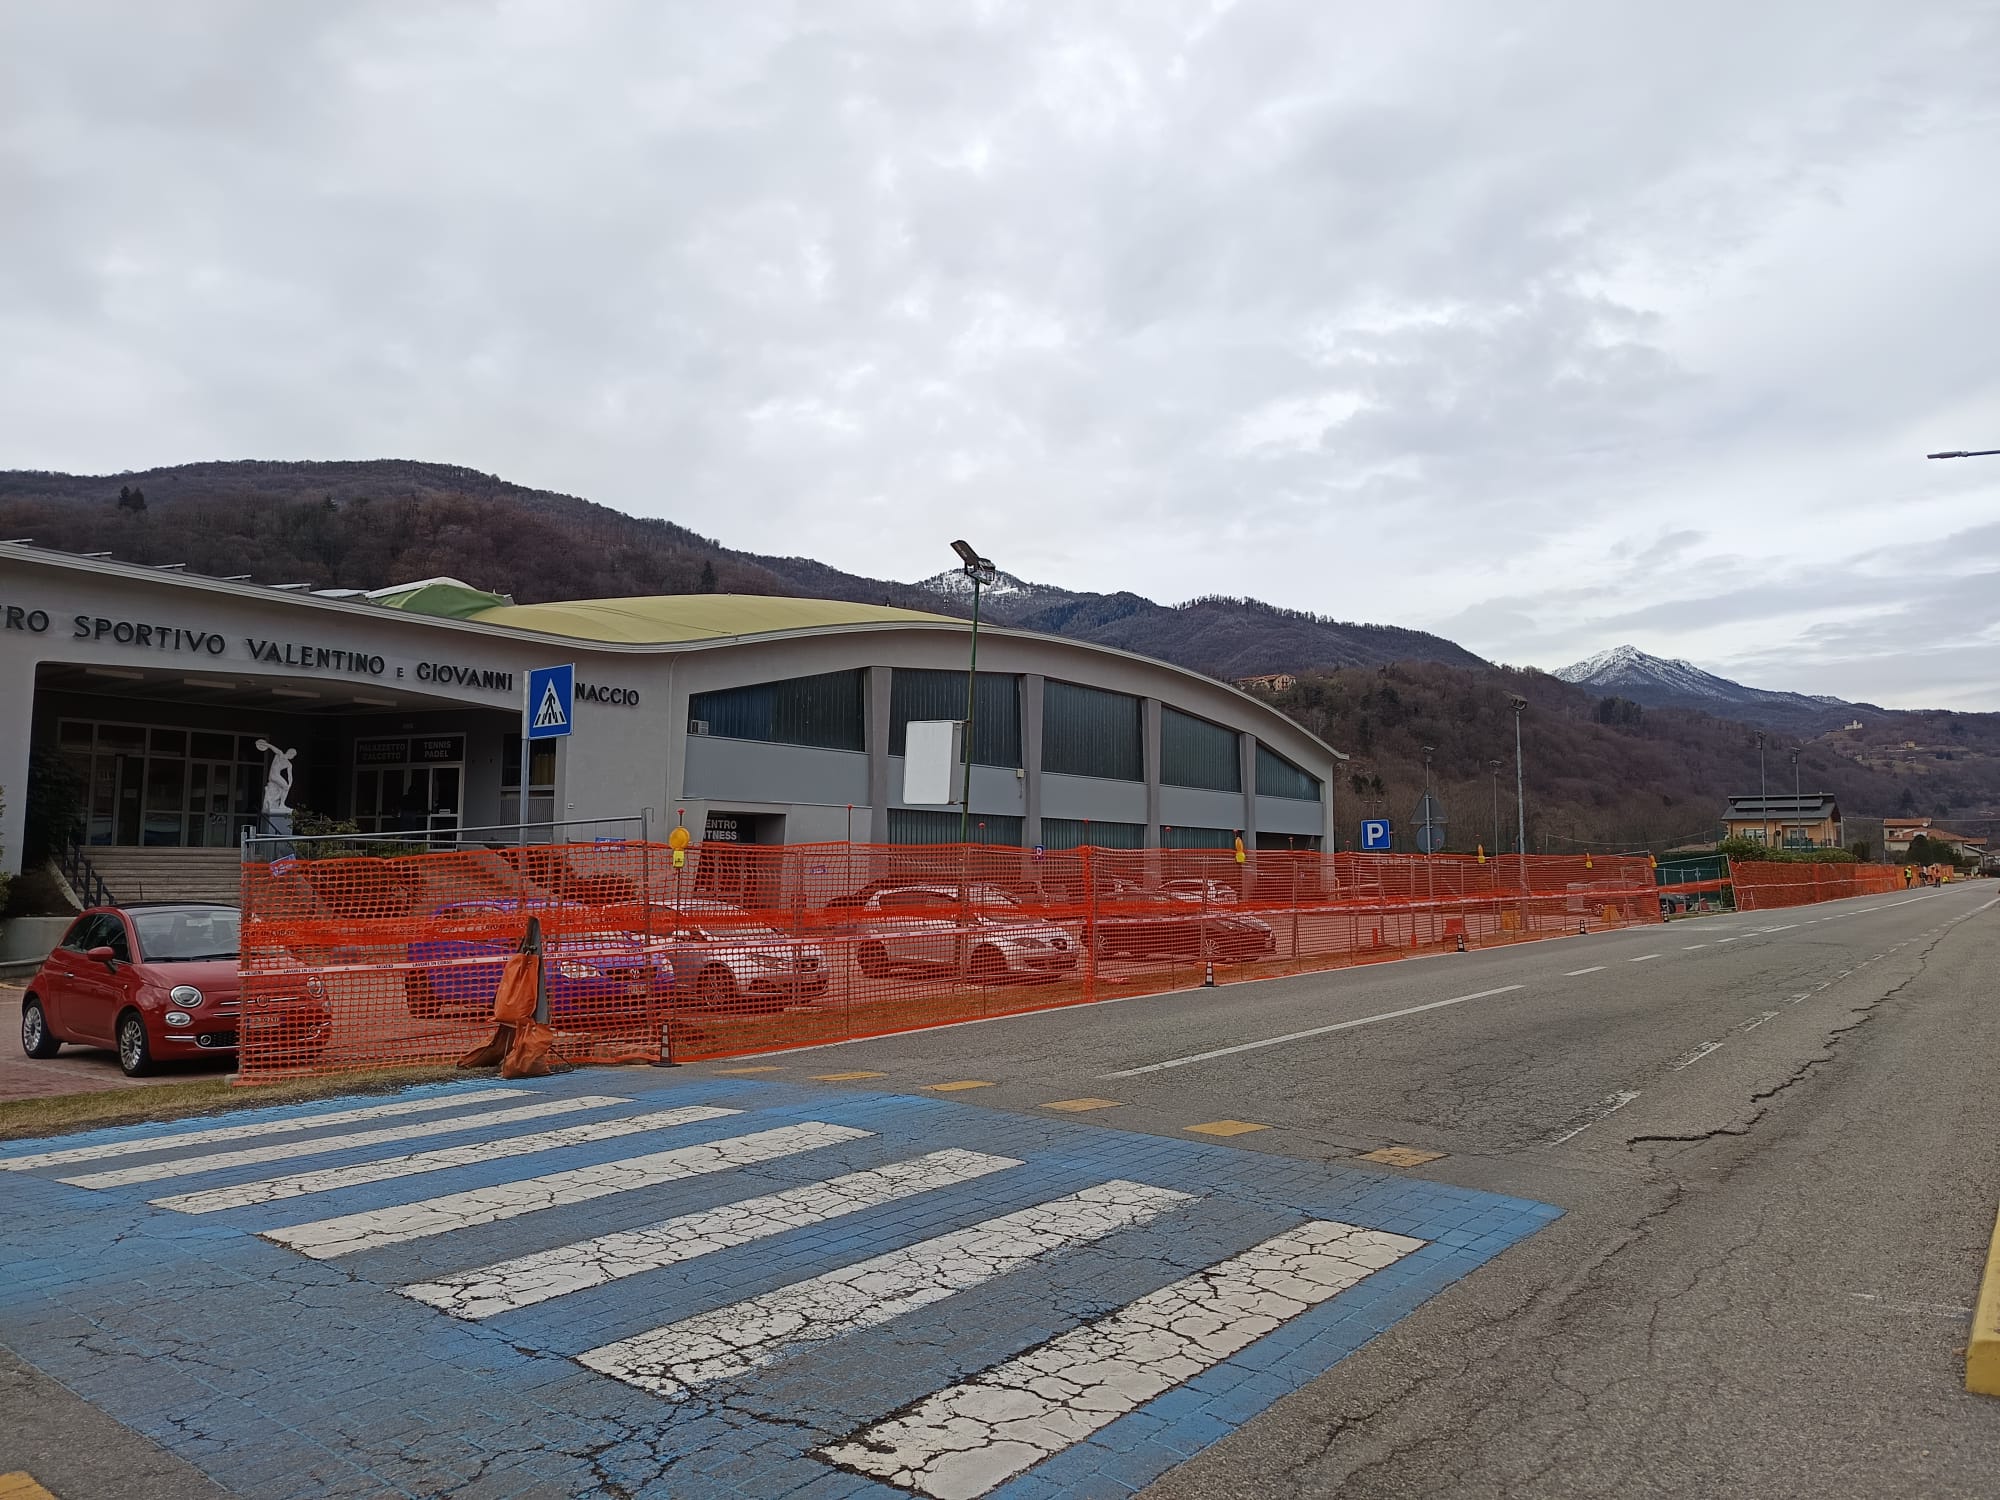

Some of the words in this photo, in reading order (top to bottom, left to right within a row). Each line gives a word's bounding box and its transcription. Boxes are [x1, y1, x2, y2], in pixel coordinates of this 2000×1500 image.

[73, 615, 226, 655] SPORTIVO
[246, 638, 386, 675] VALENTINO
[396, 667, 404, 678] E
[416, 662, 513, 691] GIOVANNI
[424, 741, 452, 750] TENNIS
[424, 750, 449, 758] PADEL
[704, 819, 738, 829] ENTRO
[1367, 823, 1384, 846] P
